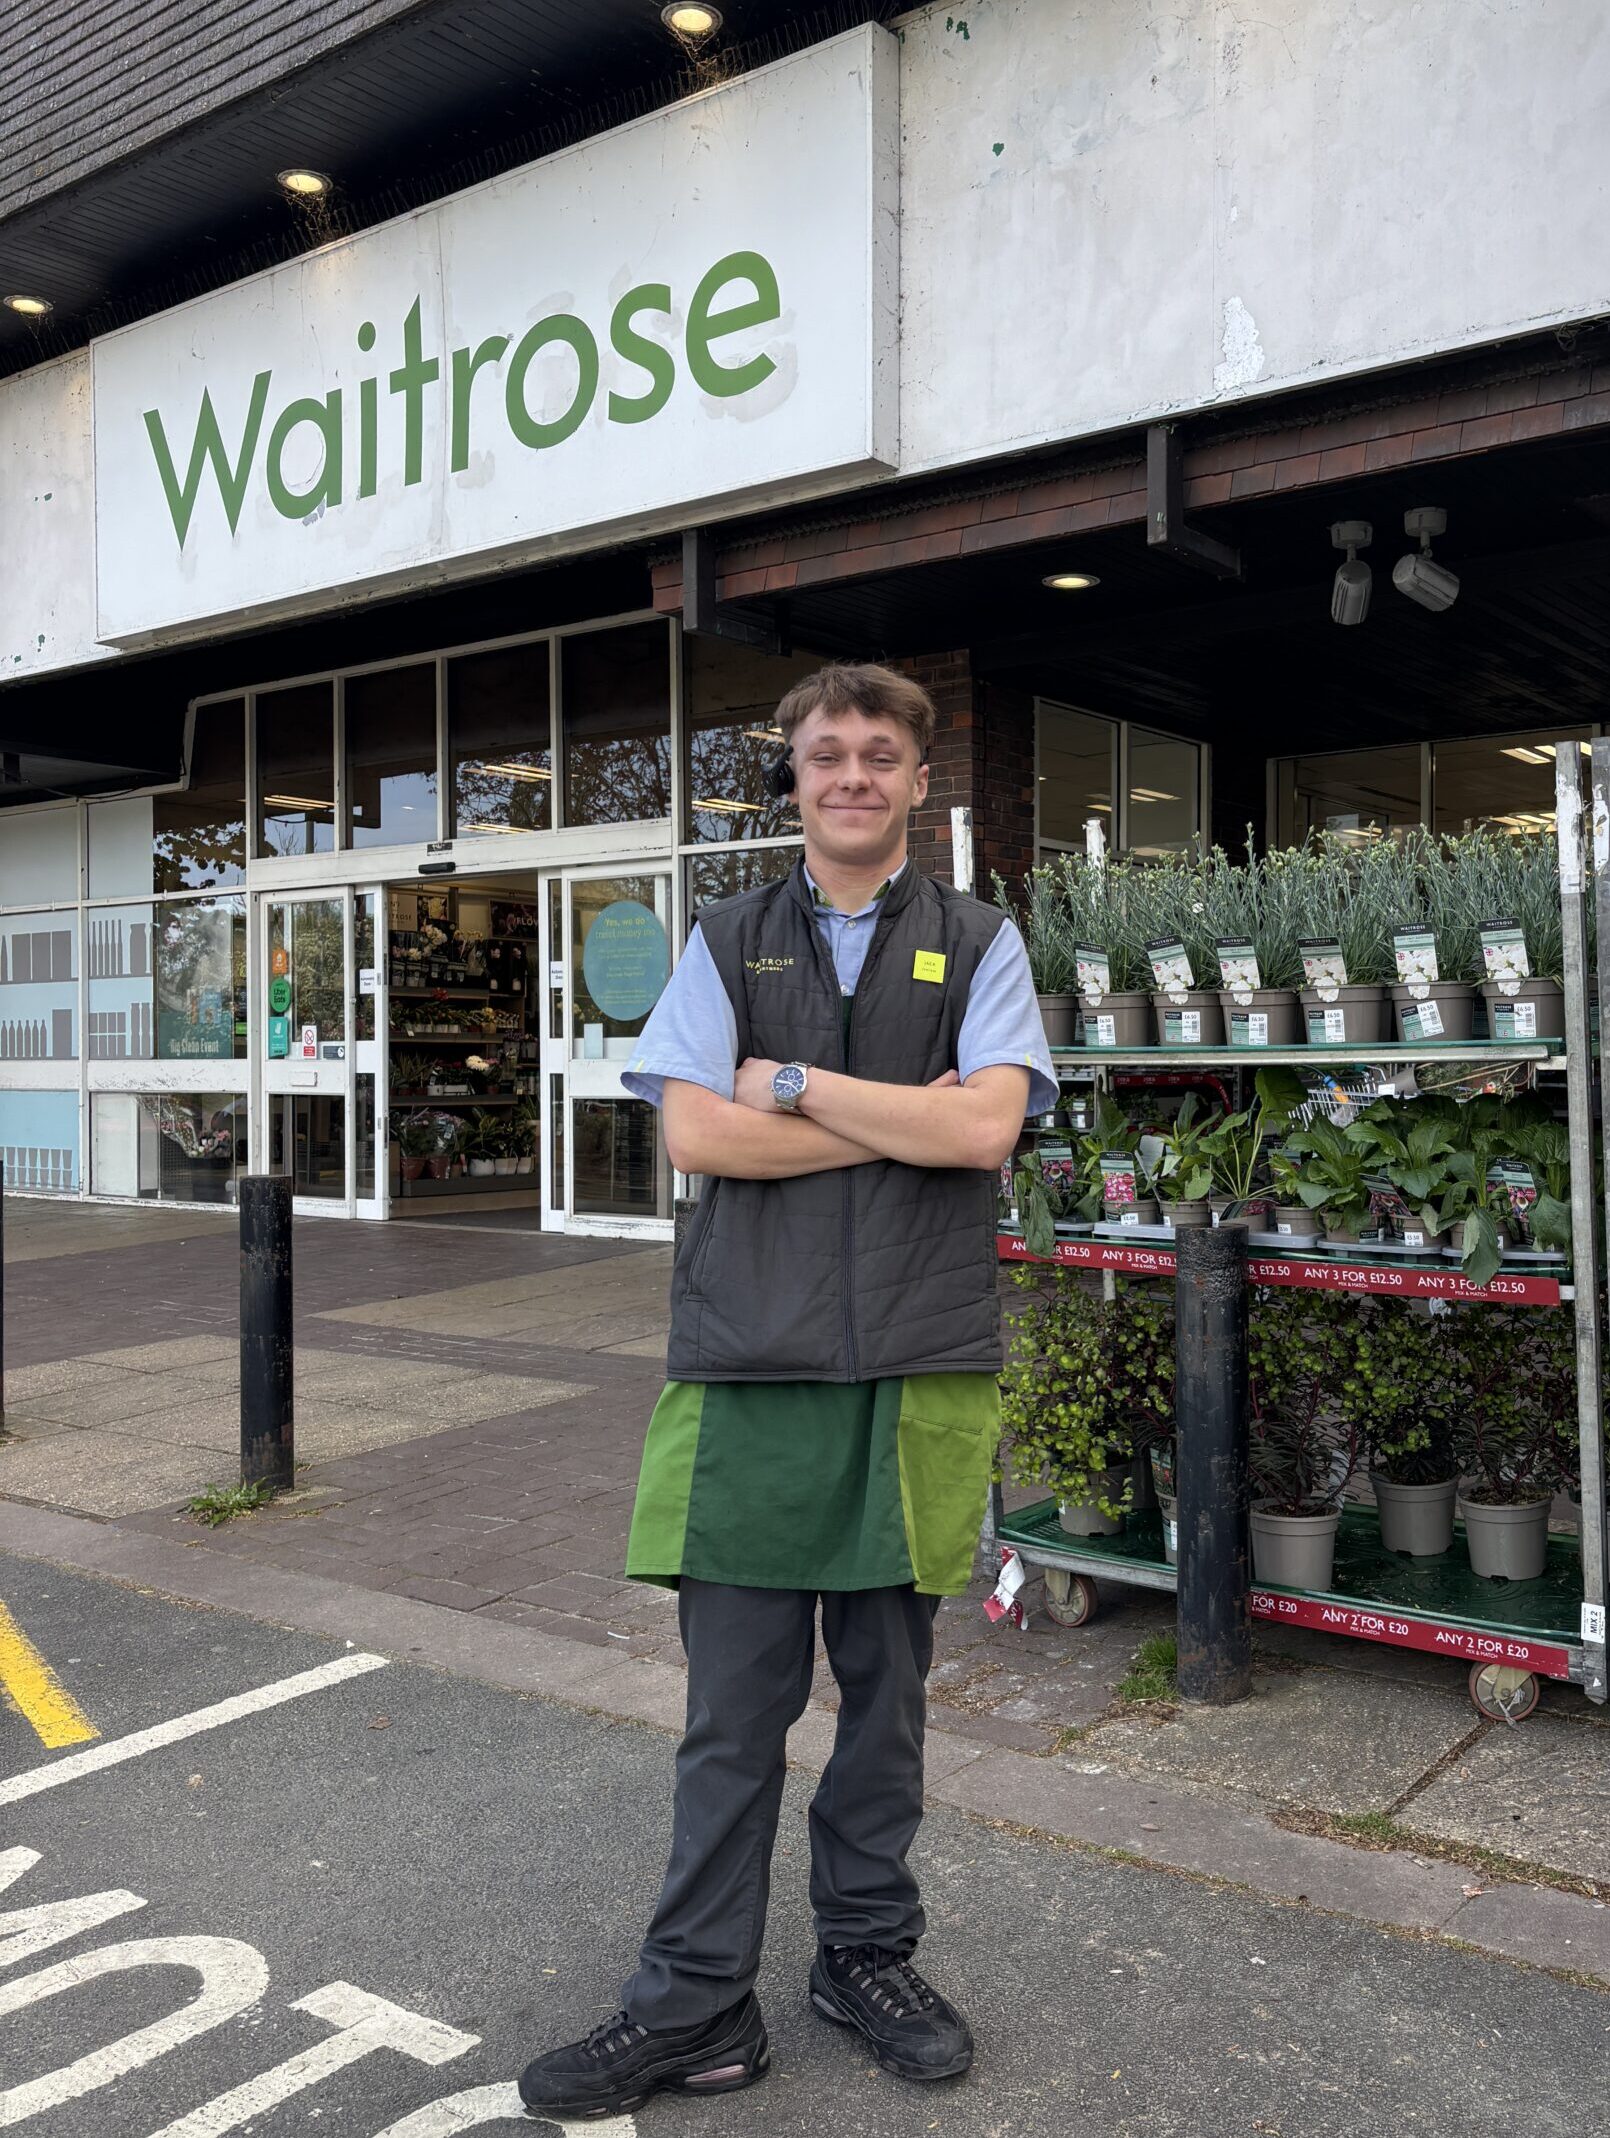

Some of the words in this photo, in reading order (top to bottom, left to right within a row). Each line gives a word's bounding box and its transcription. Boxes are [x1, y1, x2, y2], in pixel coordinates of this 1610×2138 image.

[143, 251, 781, 551] Waitrose
[745, 958, 794, 969] WATROSE
[1012, 1241, 1026, 1251] AN
[1064, 1246, 1090, 1257] £12.50
[1102, 1250, 1124, 1261] ANY
[1127, 1253, 1132, 1262] 3
[1135, 1253, 1156, 1265] FOR
[1260, 1265, 1290, 1276] £12.50
[1304, 1268, 1329, 1279] ANY
[1333, 1270, 1339, 1280] 3
[1342, 1271, 1367, 1283] FOR
[1370, 1273, 1402, 1285] £12.50
[1418, 1276, 1444, 1289] ANY
[1449, 1278, 1455, 1289] 3
[1490, 1281, 1525, 1294] £12.50
[1253, 1595, 1275, 1609] FOR
[1278, 1600, 1297, 1613] £20
[1322, 1609, 1348, 1623] ANY
[1351, 1614, 1358, 1626] 2
[1361, 1616, 1385, 1631] FOR
[1389, 1622, 1409, 1635] £20
[1590, 1618, 1598, 1634] MIX
[1436, 1631, 1463, 1646] ANY
[1467, 1637, 1474, 1648] 2
[1477, 1639, 1503, 1654] FOR
[1507, 1643, 1529, 1658] £20
